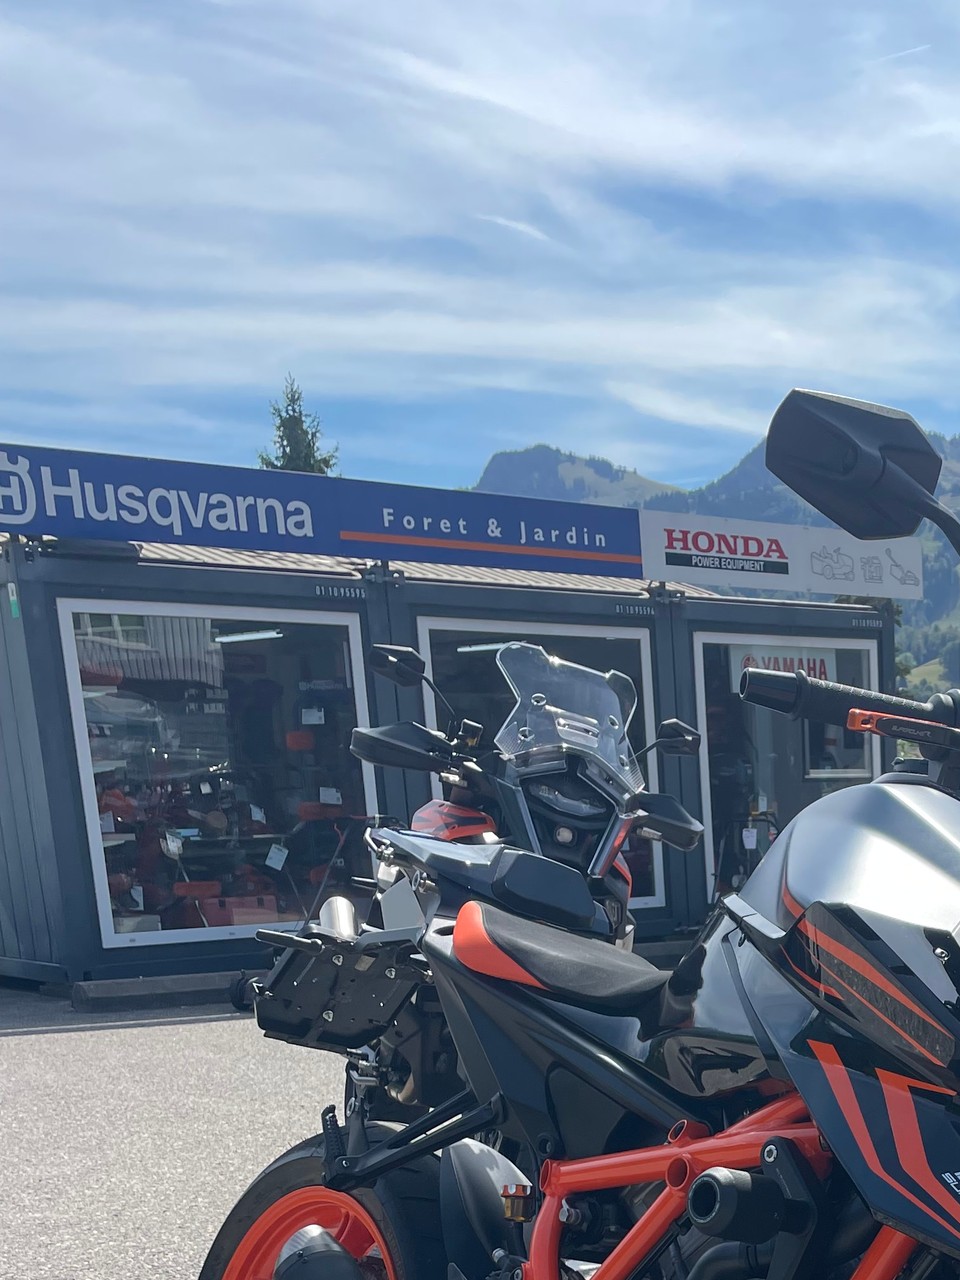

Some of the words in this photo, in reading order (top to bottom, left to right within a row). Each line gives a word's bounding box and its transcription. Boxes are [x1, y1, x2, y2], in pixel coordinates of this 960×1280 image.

[40, 465, 314, 537] Husqvarna
[382, 508, 467, 534] Foret
[487, 518, 502, 538] &
[519, 521, 606, 547] Jardin
[664, 528, 788, 560] HONDA
[692, 555, 720, 568] POWER
[721, 558, 765, 572] EQUIPMENT
